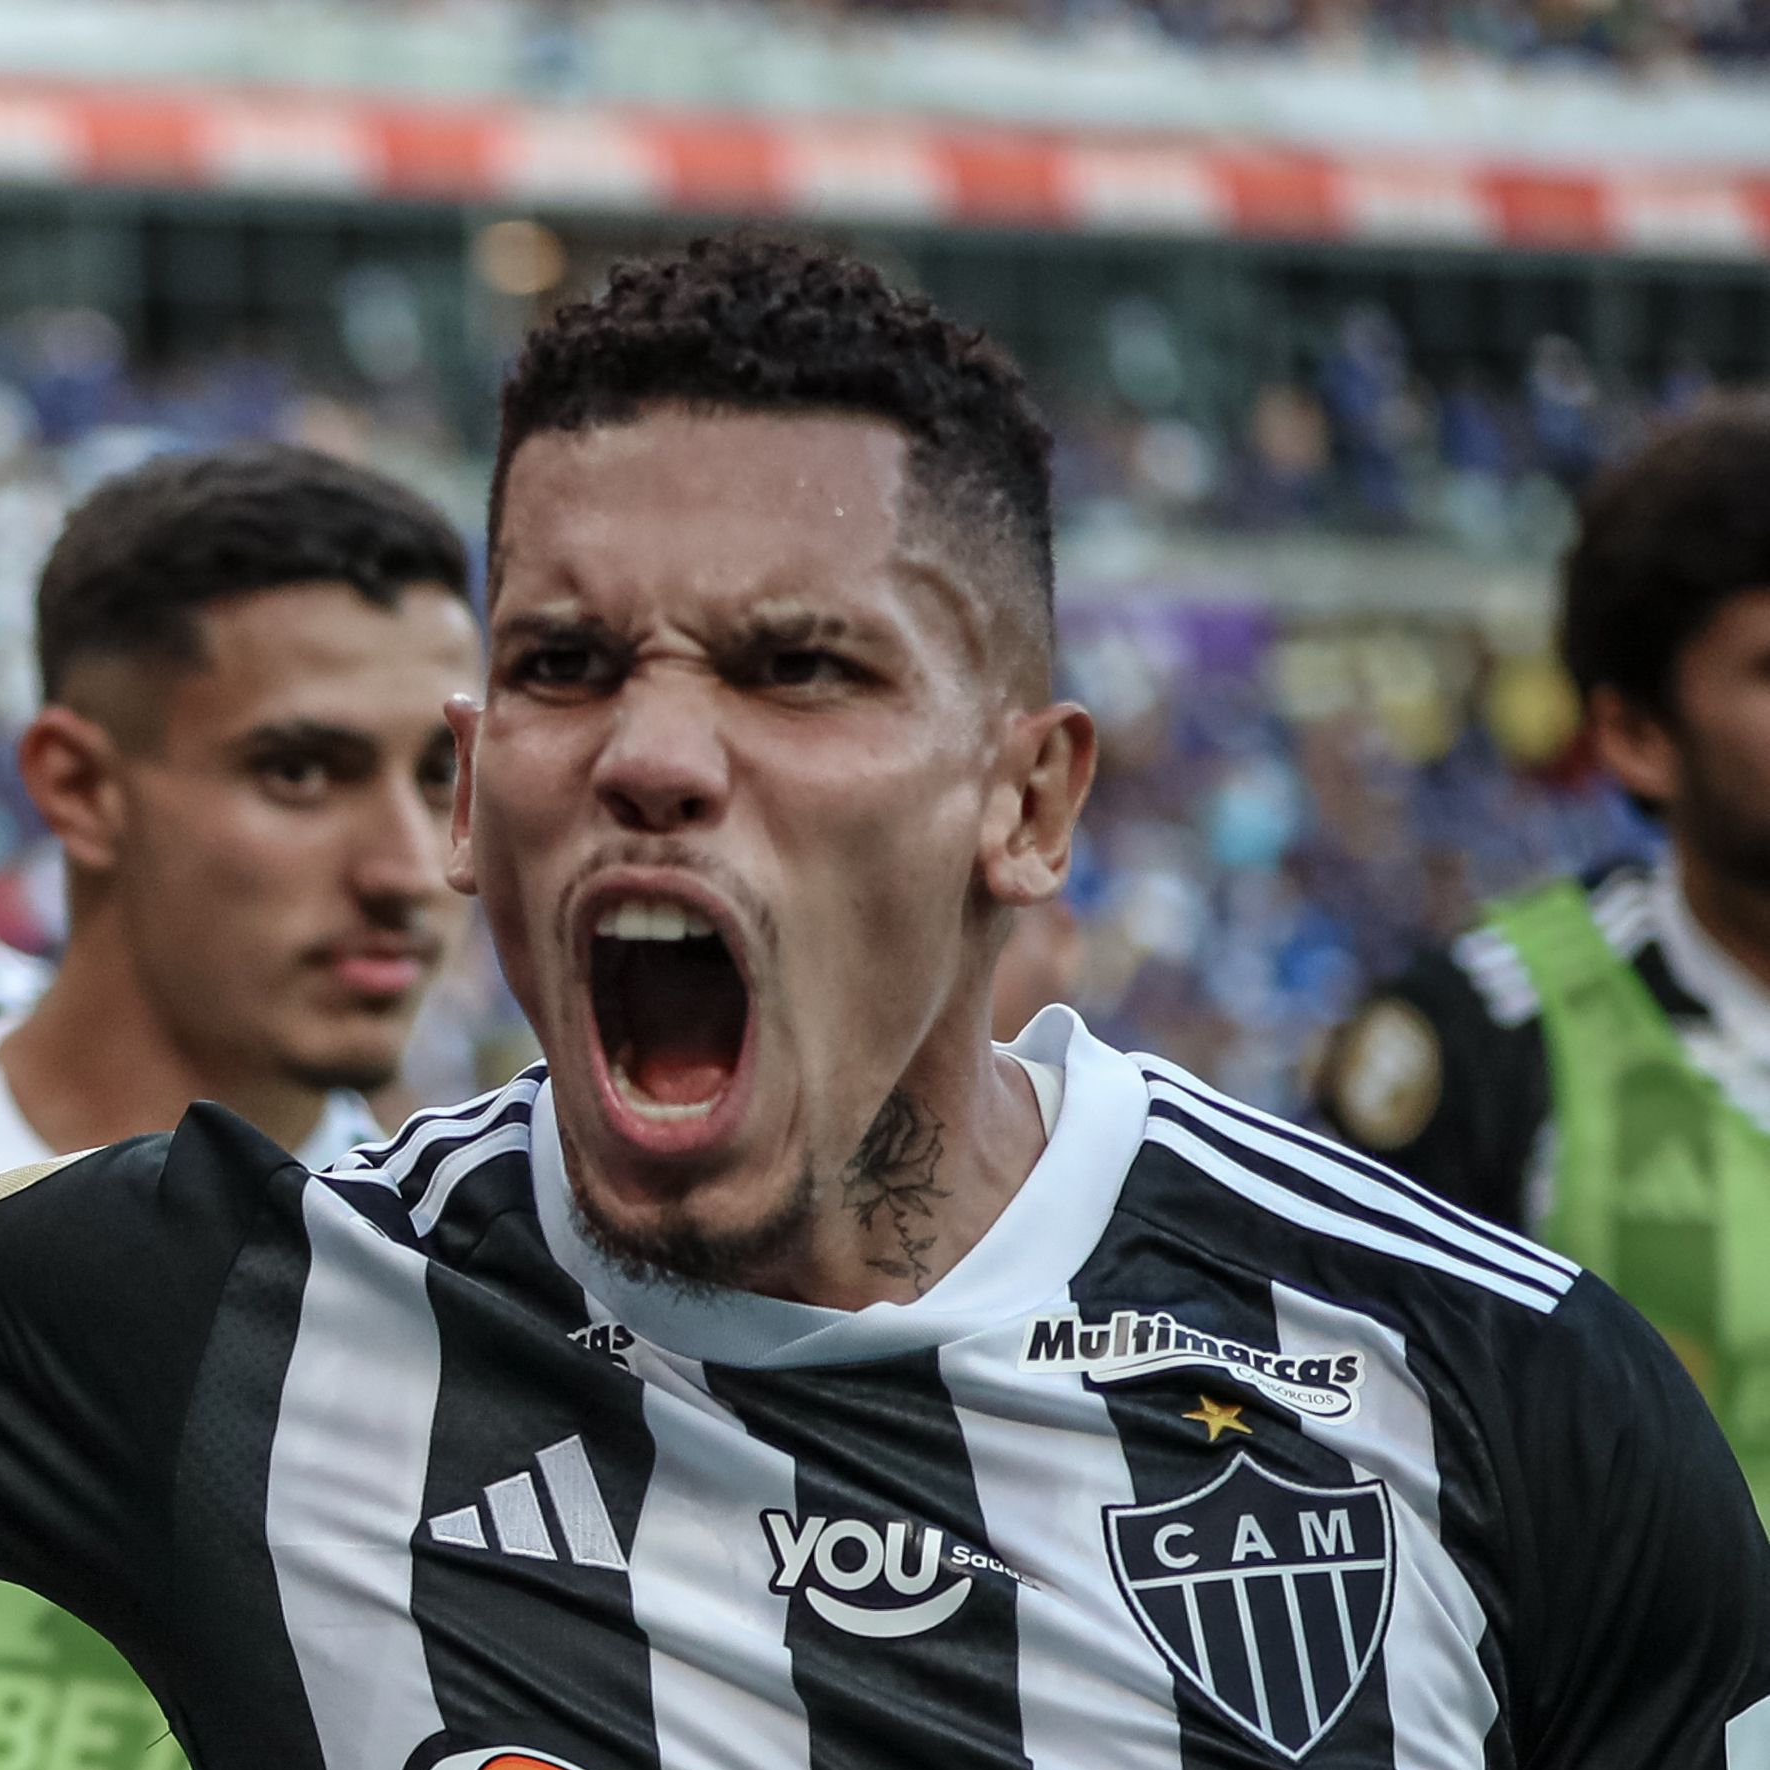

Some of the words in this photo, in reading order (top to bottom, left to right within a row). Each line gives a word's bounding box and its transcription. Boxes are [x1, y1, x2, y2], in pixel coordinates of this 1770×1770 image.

[1026, 1313, 1358, 1384] Multimarcas
[765, 1512, 944, 1596] YOU
[1150, 1507, 1356, 1572] CAM
